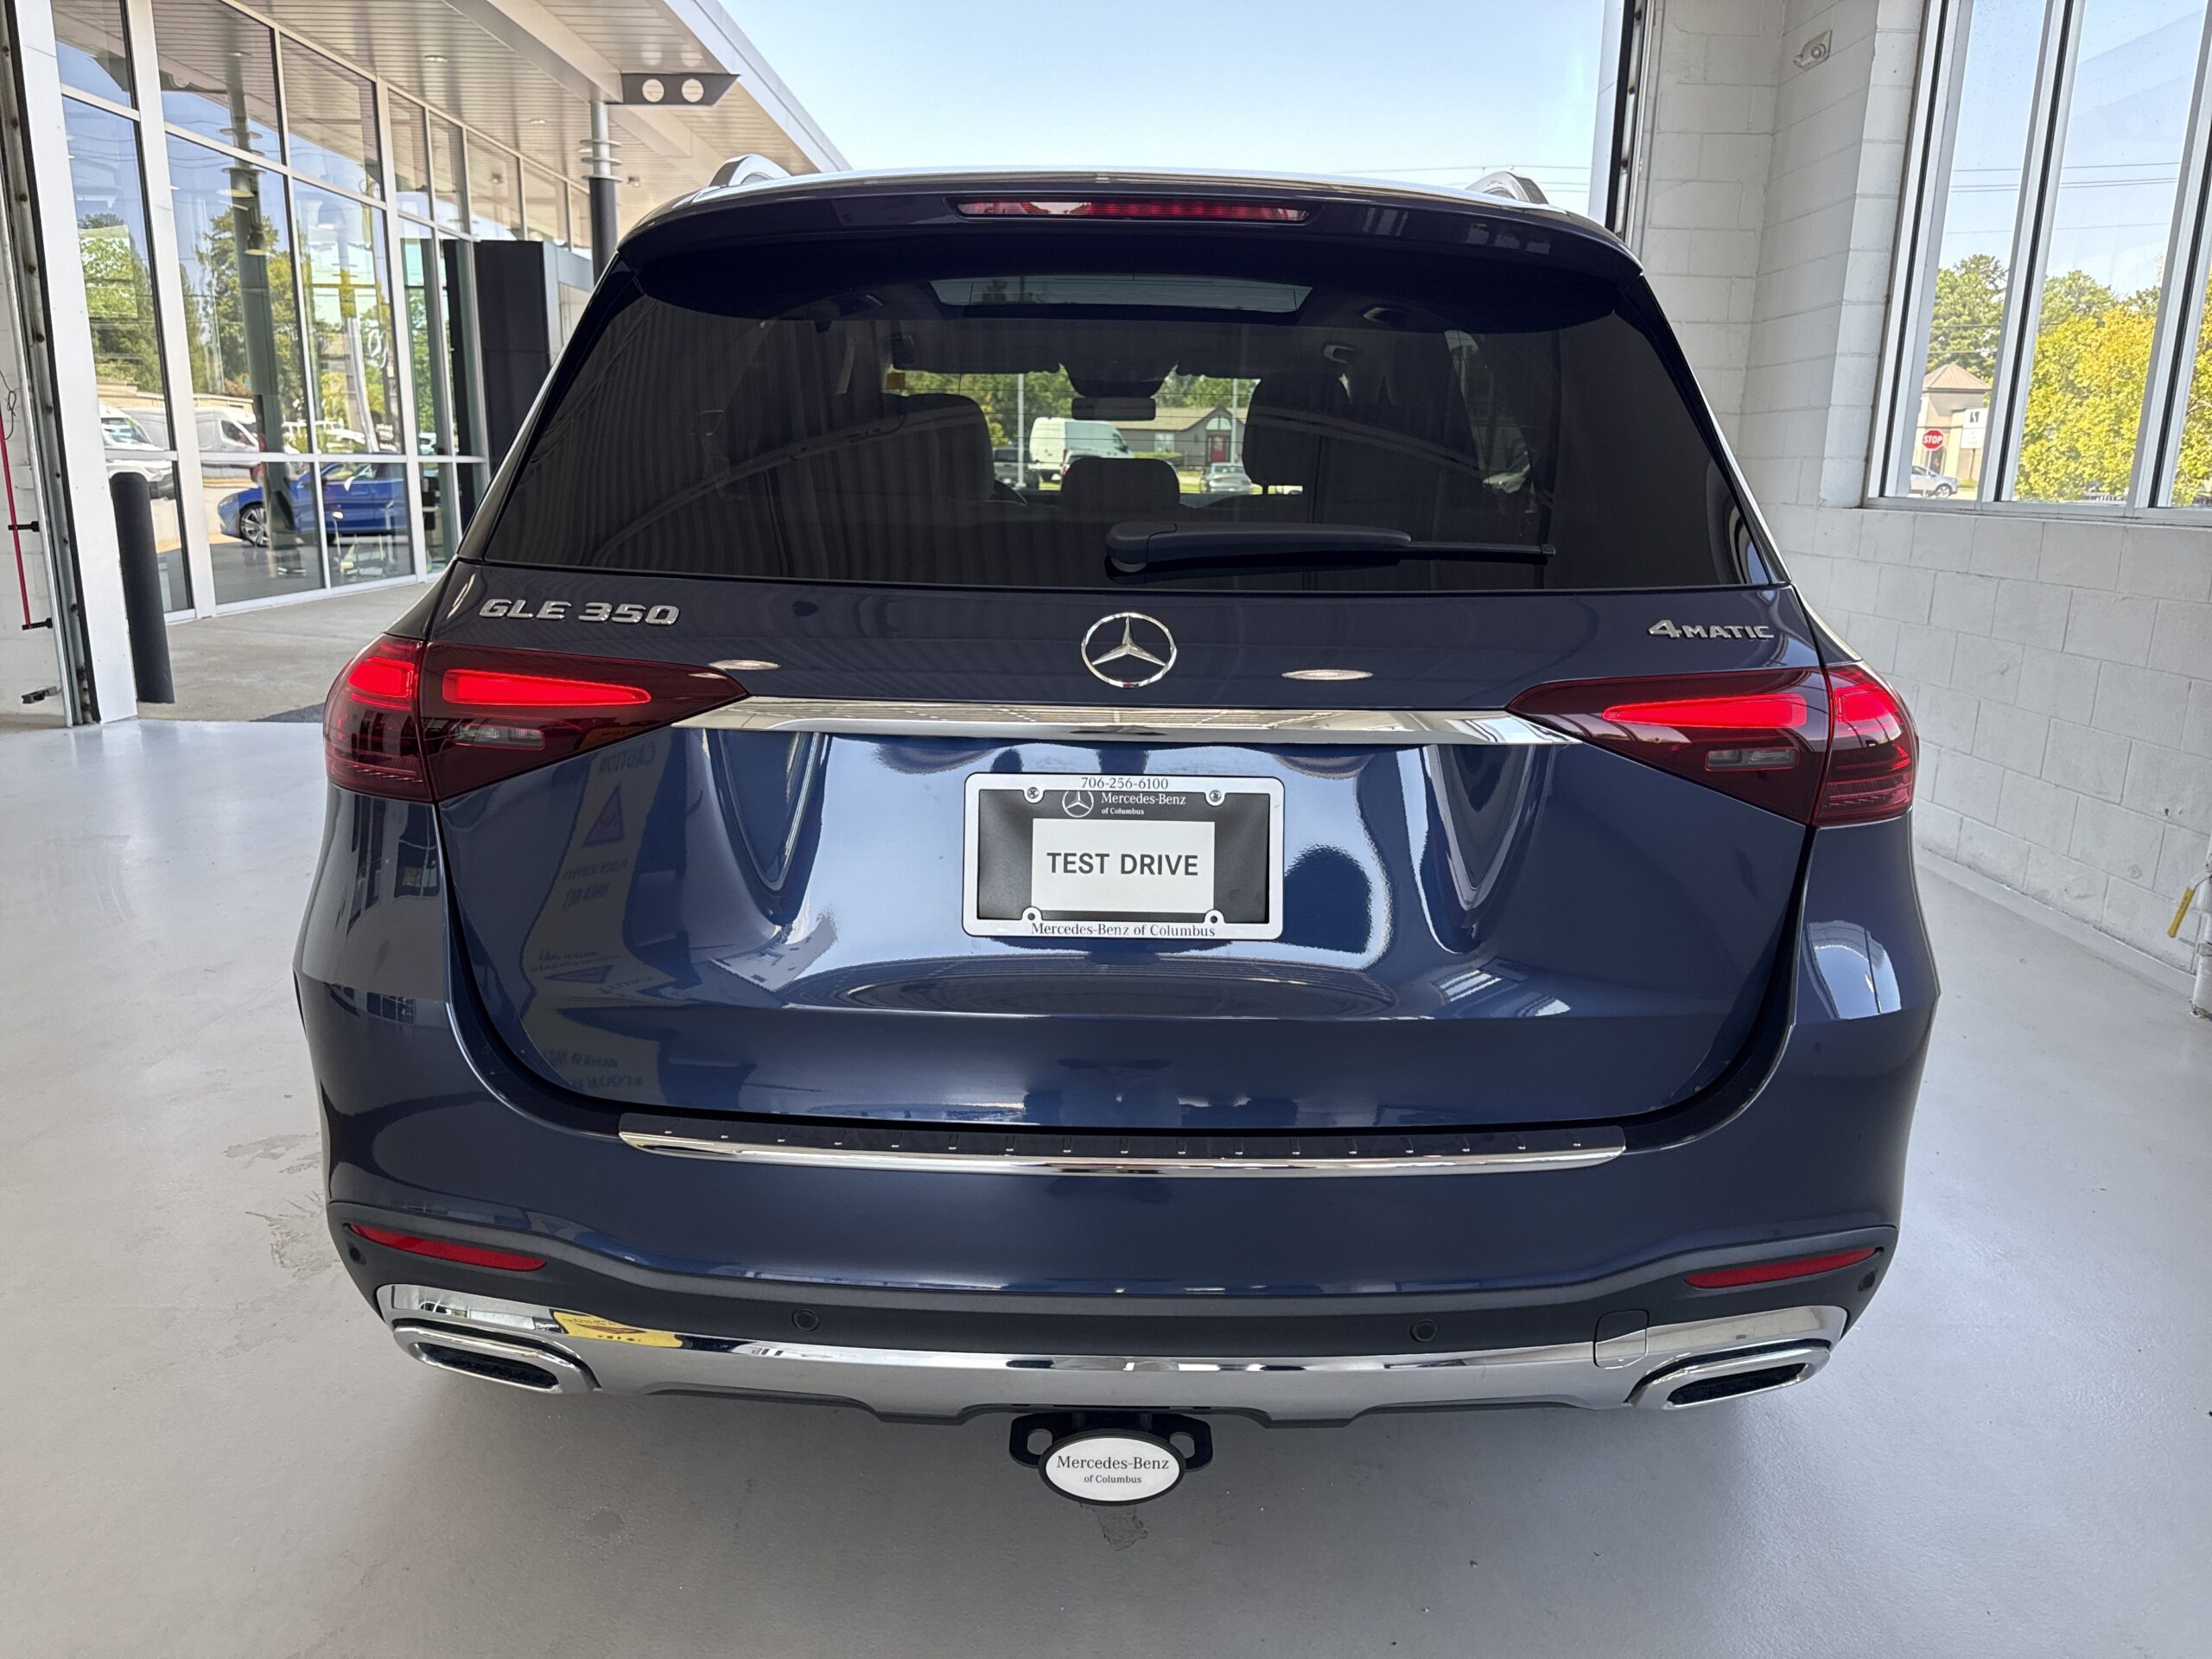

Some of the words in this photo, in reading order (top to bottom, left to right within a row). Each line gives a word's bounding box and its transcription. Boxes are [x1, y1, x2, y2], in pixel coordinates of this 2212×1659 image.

[1923, 435, 1943, 443] STOP
[479, 598, 572, 620] GLE
[578, 601, 680, 626] 350
[1648, 620, 1774, 640] 4MATIC
[1081, 777, 1168, 790] 706-256-6100
[1101, 792, 1186, 805] Mercedes-Benz
[1047, 852, 1110, 874] TEST
[1121, 854, 1198, 875] DRIVE
[1031, 923, 1130, 936] Mercedes-Benz
[1134, 925, 1147, 936] of
[1150, 925, 1216, 938] Columbus
[1057, 1456, 1169, 1469] Mercedes-Benz
[1084, 1475, 1093, 1484] of
[1096, 1475, 1141, 1484] Columbus
